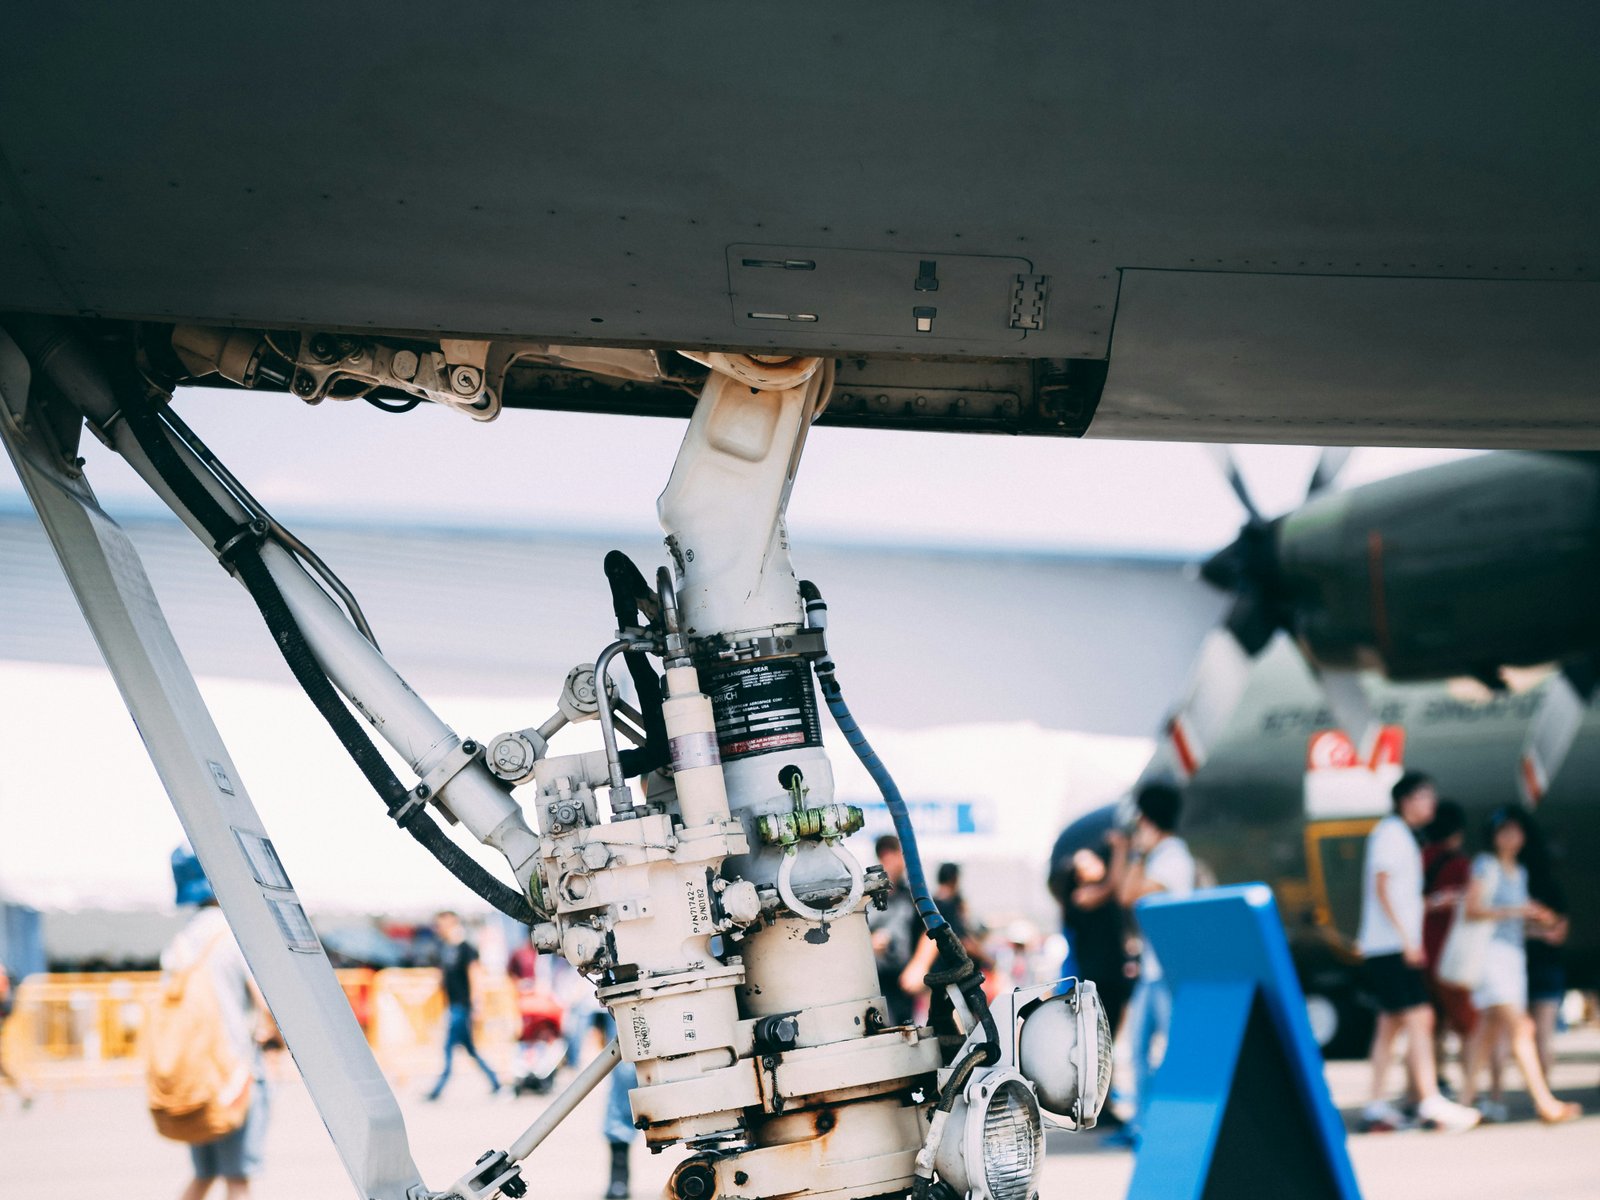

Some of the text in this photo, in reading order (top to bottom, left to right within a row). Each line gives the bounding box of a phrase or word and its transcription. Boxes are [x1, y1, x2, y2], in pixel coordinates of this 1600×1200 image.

[727, 668, 751, 678] LANDING
[753, 665, 769, 673] GEAR
[697, 889, 708, 921] S/N0182
